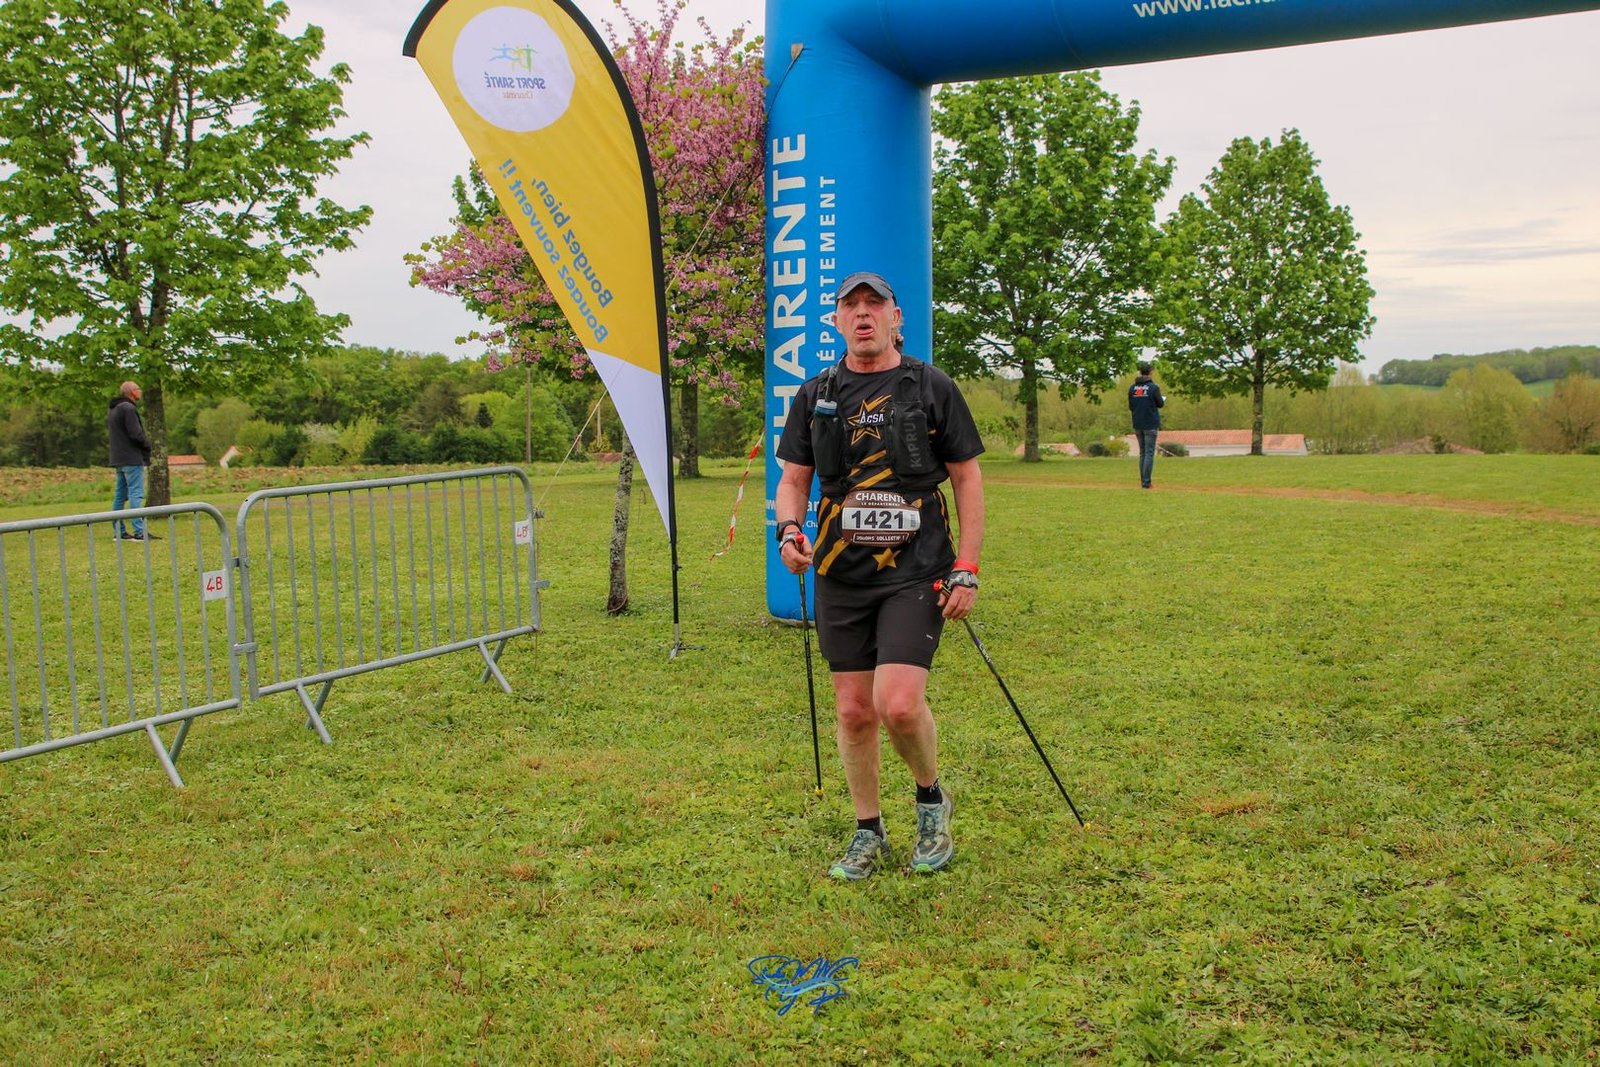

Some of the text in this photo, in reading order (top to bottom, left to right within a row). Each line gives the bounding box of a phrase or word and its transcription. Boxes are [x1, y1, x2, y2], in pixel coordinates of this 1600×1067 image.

[816, 176, 836, 374] ÉPARTEMENT
[851, 510, 904, 529] 1421
[206, 576, 223, 592] 4B
